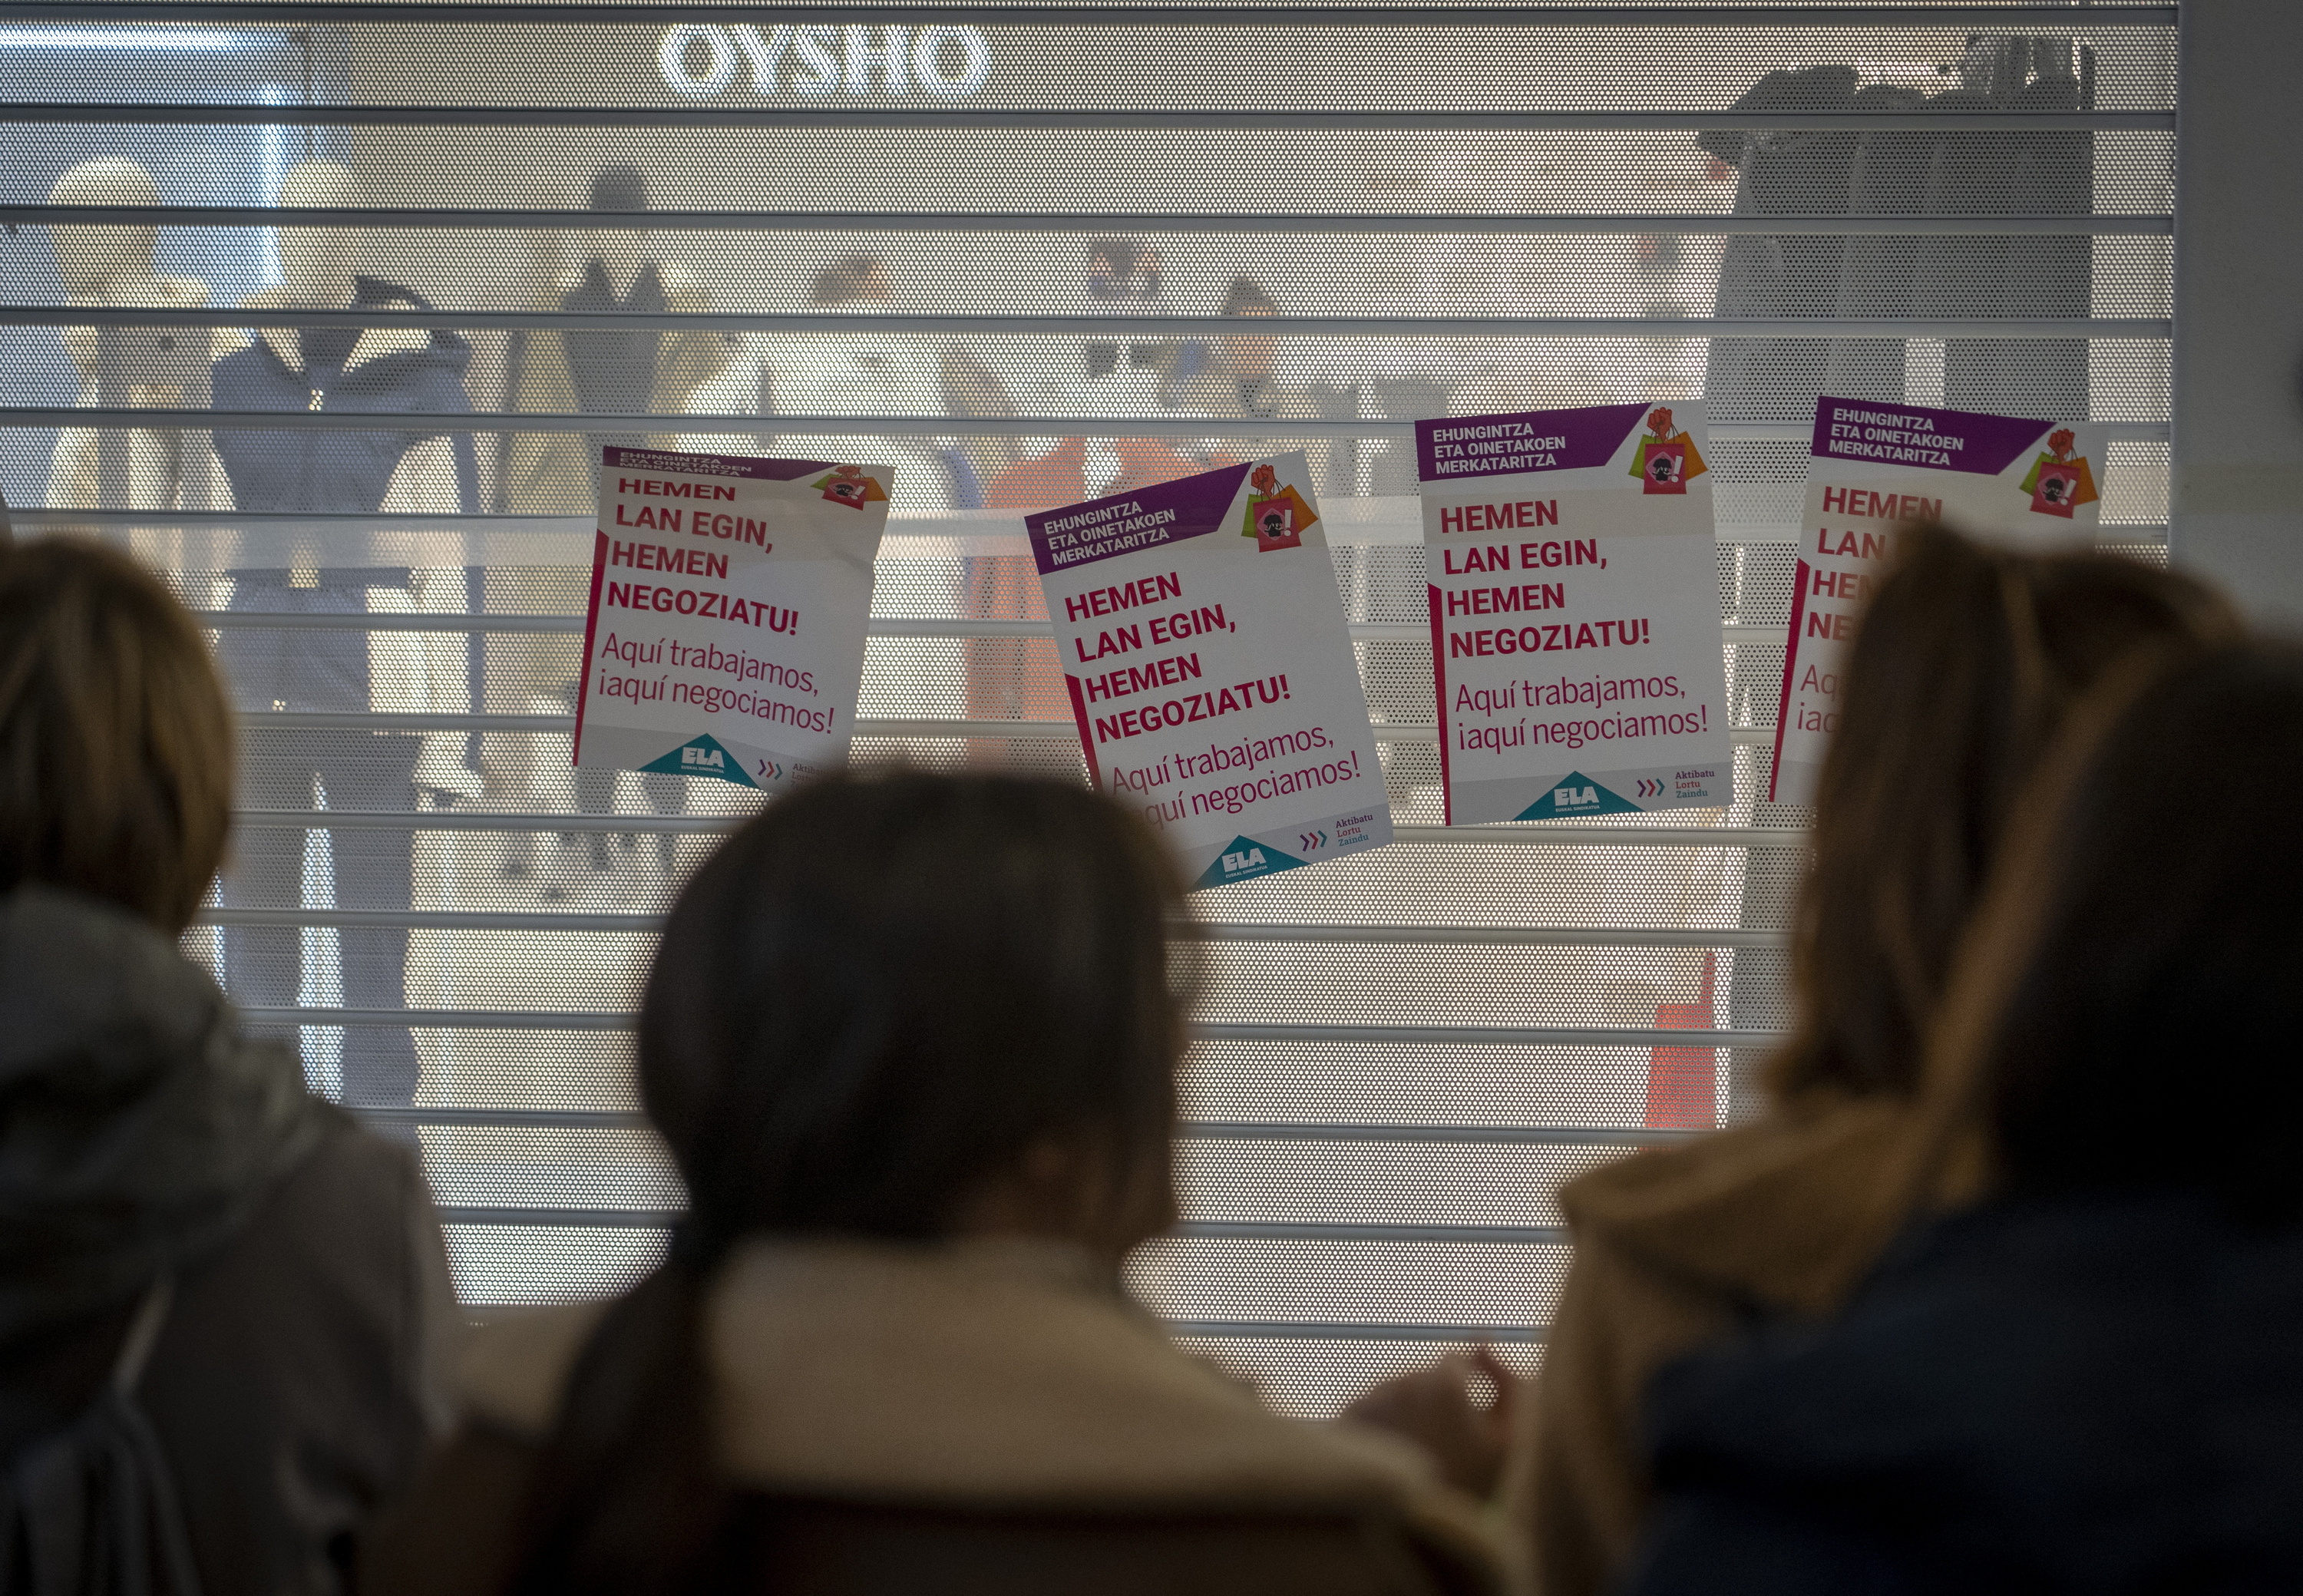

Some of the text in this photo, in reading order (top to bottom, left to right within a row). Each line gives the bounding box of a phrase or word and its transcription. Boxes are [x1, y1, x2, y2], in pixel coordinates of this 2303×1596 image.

[659, 23, 989, 98] OYSHO
[1432, 422, 1534, 444] EHUNGINTZA
[1832, 408, 1935, 431] EHUNGINTZA
[1434, 436, 1566, 459] ETA OINETAKOEN
[1829, 439, 1950, 466] MERKATARITZA
[1831, 424, 1964, 451] ETA OINETAKOEN
[620, 452, 721, 464] EHUNGINTZA
[620, 462, 740, 476] MERKATARITZA
[653, 459, 752, 472] OINETAKOEN
[1436, 453, 1557, 474] MERKATARITZA
[618, 477, 735, 501] HEMEN
[1822, 487, 1943, 522] HEMEN
[616, 504, 773, 554] LAN EGIN,
[1044, 501, 1142, 535] EHUNGINTZA
[1049, 508, 1176, 551] ETA OINETAKOEN
[1440, 499, 1558, 534] HEMEN
[611, 540, 729, 579] HEMEN
[1052, 527, 1170, 567] MERKATARITZA
[1443, 539, 1607, 575] LAN EGIN,
[1818, 528, 1886, 560] LAN
[607, 581, 798, 636] NEGOZIATU!
[1064, 571, 1182, 622] HEMEN
[1446, 582, 1565, 616] HEMEN
[1075, 603, 1237, 663] LAN EGIN,
[1450, 618, 1650, 659] NEGOZIATU!
[601, 633, 818, 697] Aquí trabajamos,
[1085, 653, 1202, 703] HEMEN
[599, 669, 834, 734] ¡aquí negociamos!
[1095, 674, 1291, 743] NEGOZIATU!
[1455, 674, 1686, 717] Aquí trabajamos,
[1459, 705, 1708, 755] ¡aquí negociamos!
[682, 746, 725, 768] ELA
[1113, 726, 1335, 795] Aquí trabajamos,
[1145, 750, 1361, 831] quí negociamos!
[1675, 770, 1715, 780] Aktibatu
[1675, 780, 1701, 789] Lortu
[1554, 786, 1600, 806] ELA
[1676, 789, 1709, 798] Zaindu
[1336, 814, 1374, 829] Aktibatu
[1337, 826, 1361, 838] Lortu
[1338, 833, 1370, 847] Zaindu
[1222, 848, 1267, 873] ELA
[1242, 864, 1268, 875] SINDIKATUA
